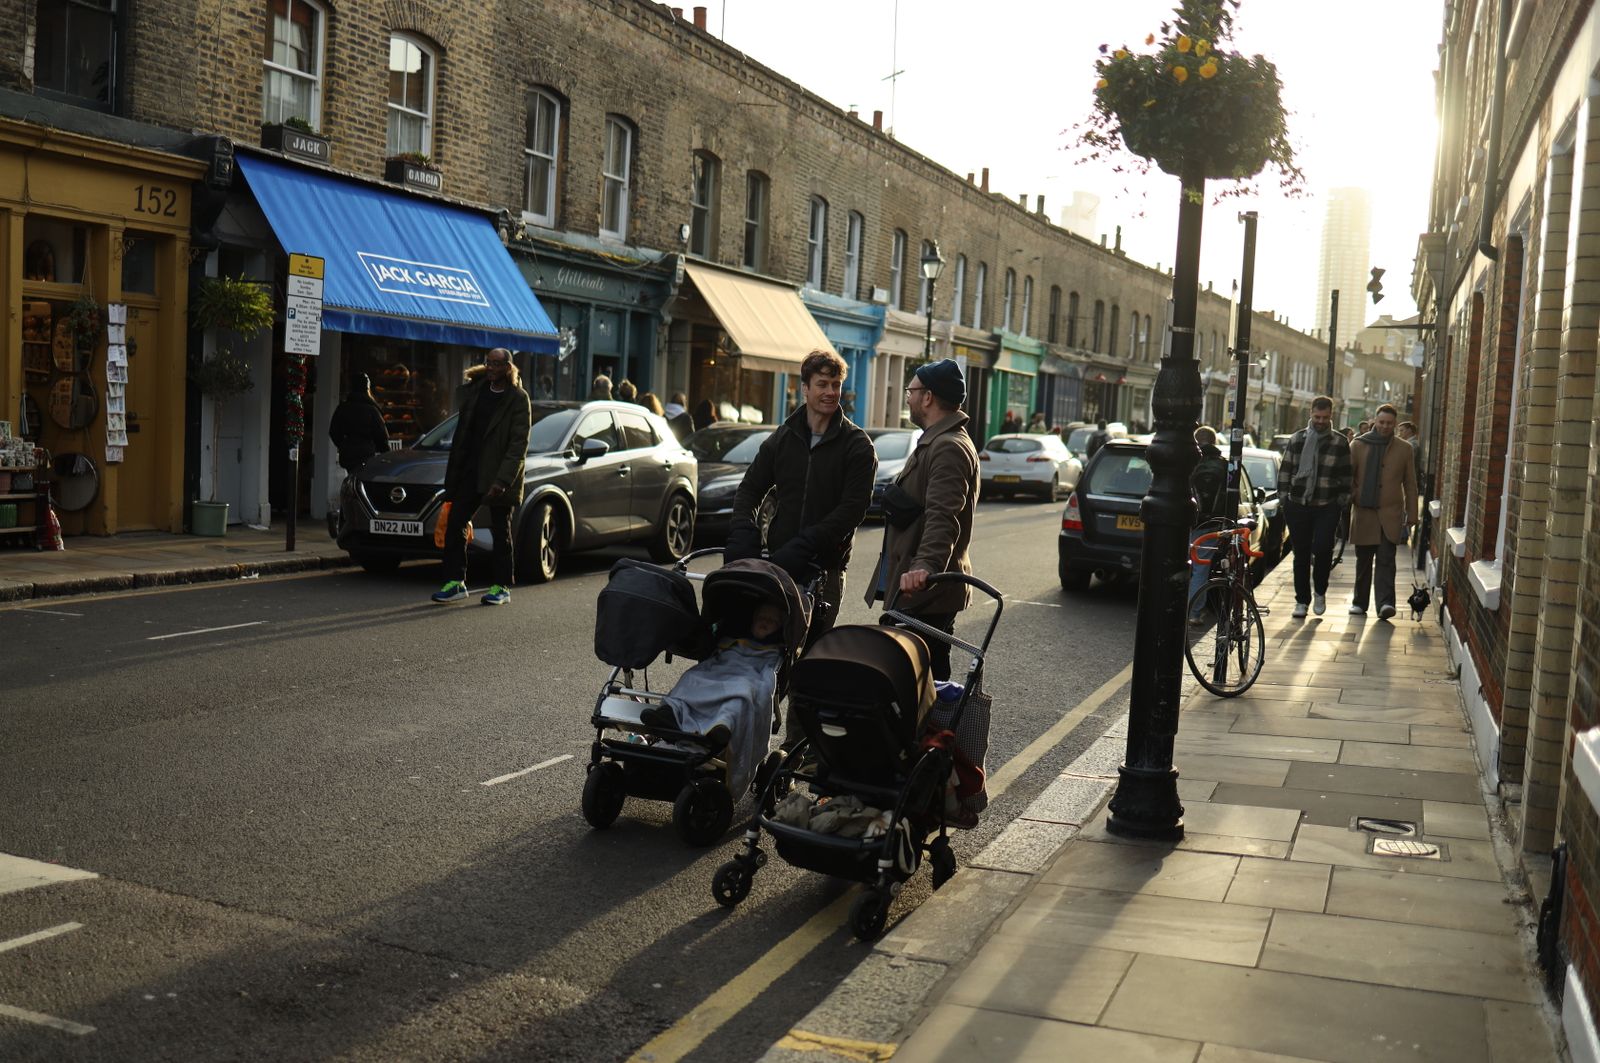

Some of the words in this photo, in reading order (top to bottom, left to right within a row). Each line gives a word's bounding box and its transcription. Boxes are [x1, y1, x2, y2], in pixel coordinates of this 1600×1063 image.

[293, 137, 320, 155] JACK
[408, 169, 438, 187] GARCIA
[134, 184, 177, 217] 152
[372, 263, 417, 283] JACK
[415, 271, 478, 293] GARCIA
[374, 520, 398, 533] DN22
[1121, 516, 1144, 528] KV5
